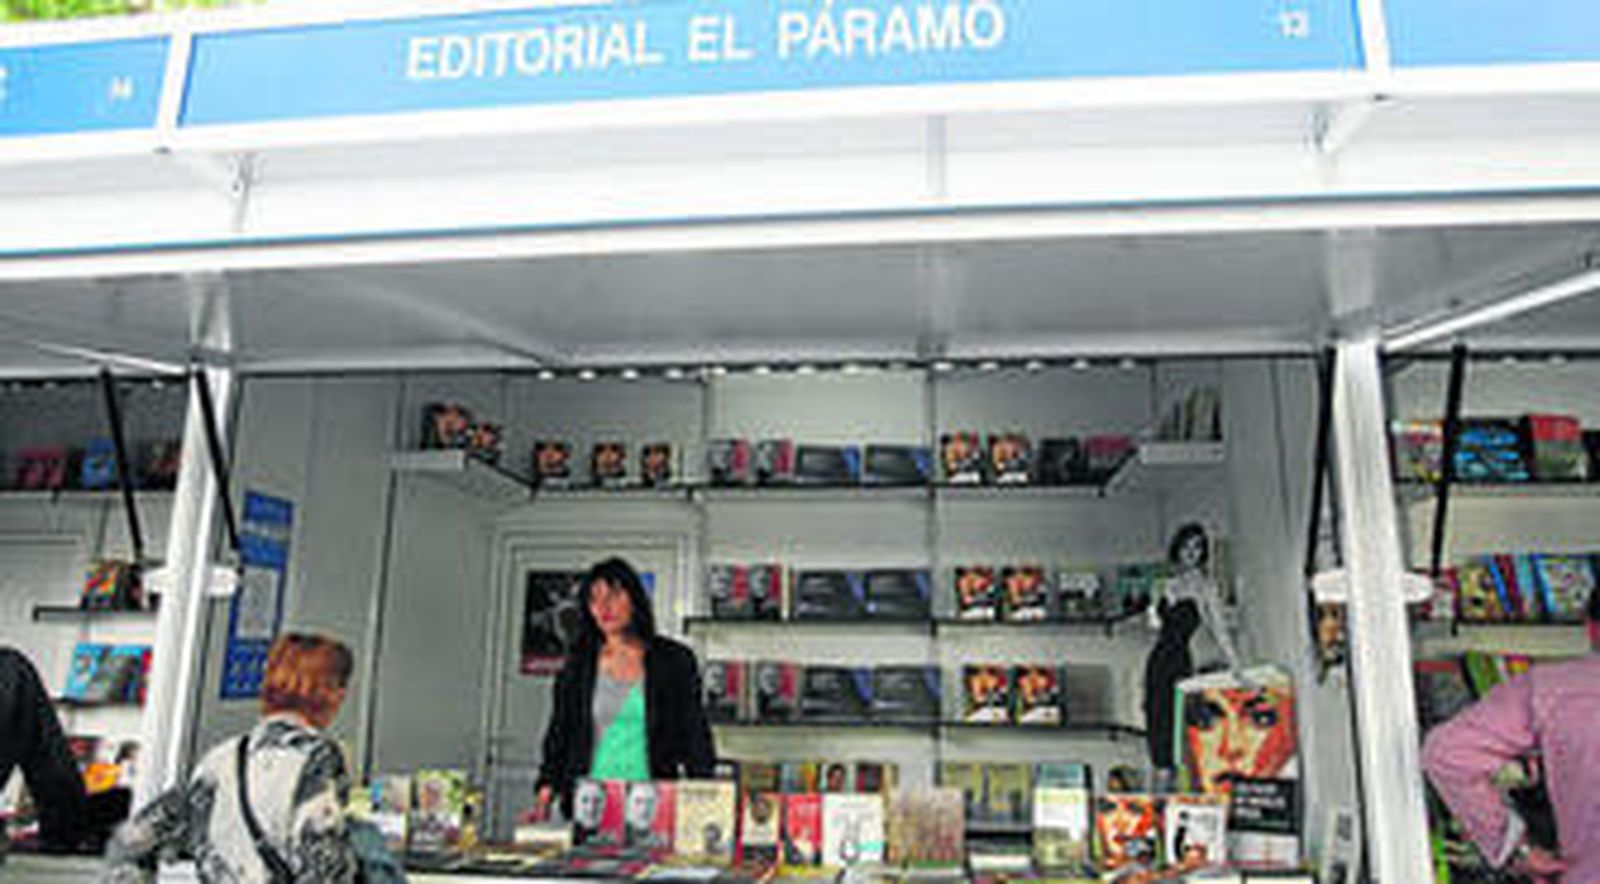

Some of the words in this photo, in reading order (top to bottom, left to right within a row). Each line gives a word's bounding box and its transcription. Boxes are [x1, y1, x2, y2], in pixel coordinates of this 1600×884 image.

[405, 20, 663, 80] EDITORIAL
[687, 13, 755, 62] EL
[777, 0, 1006, 60] PÁRAMO
